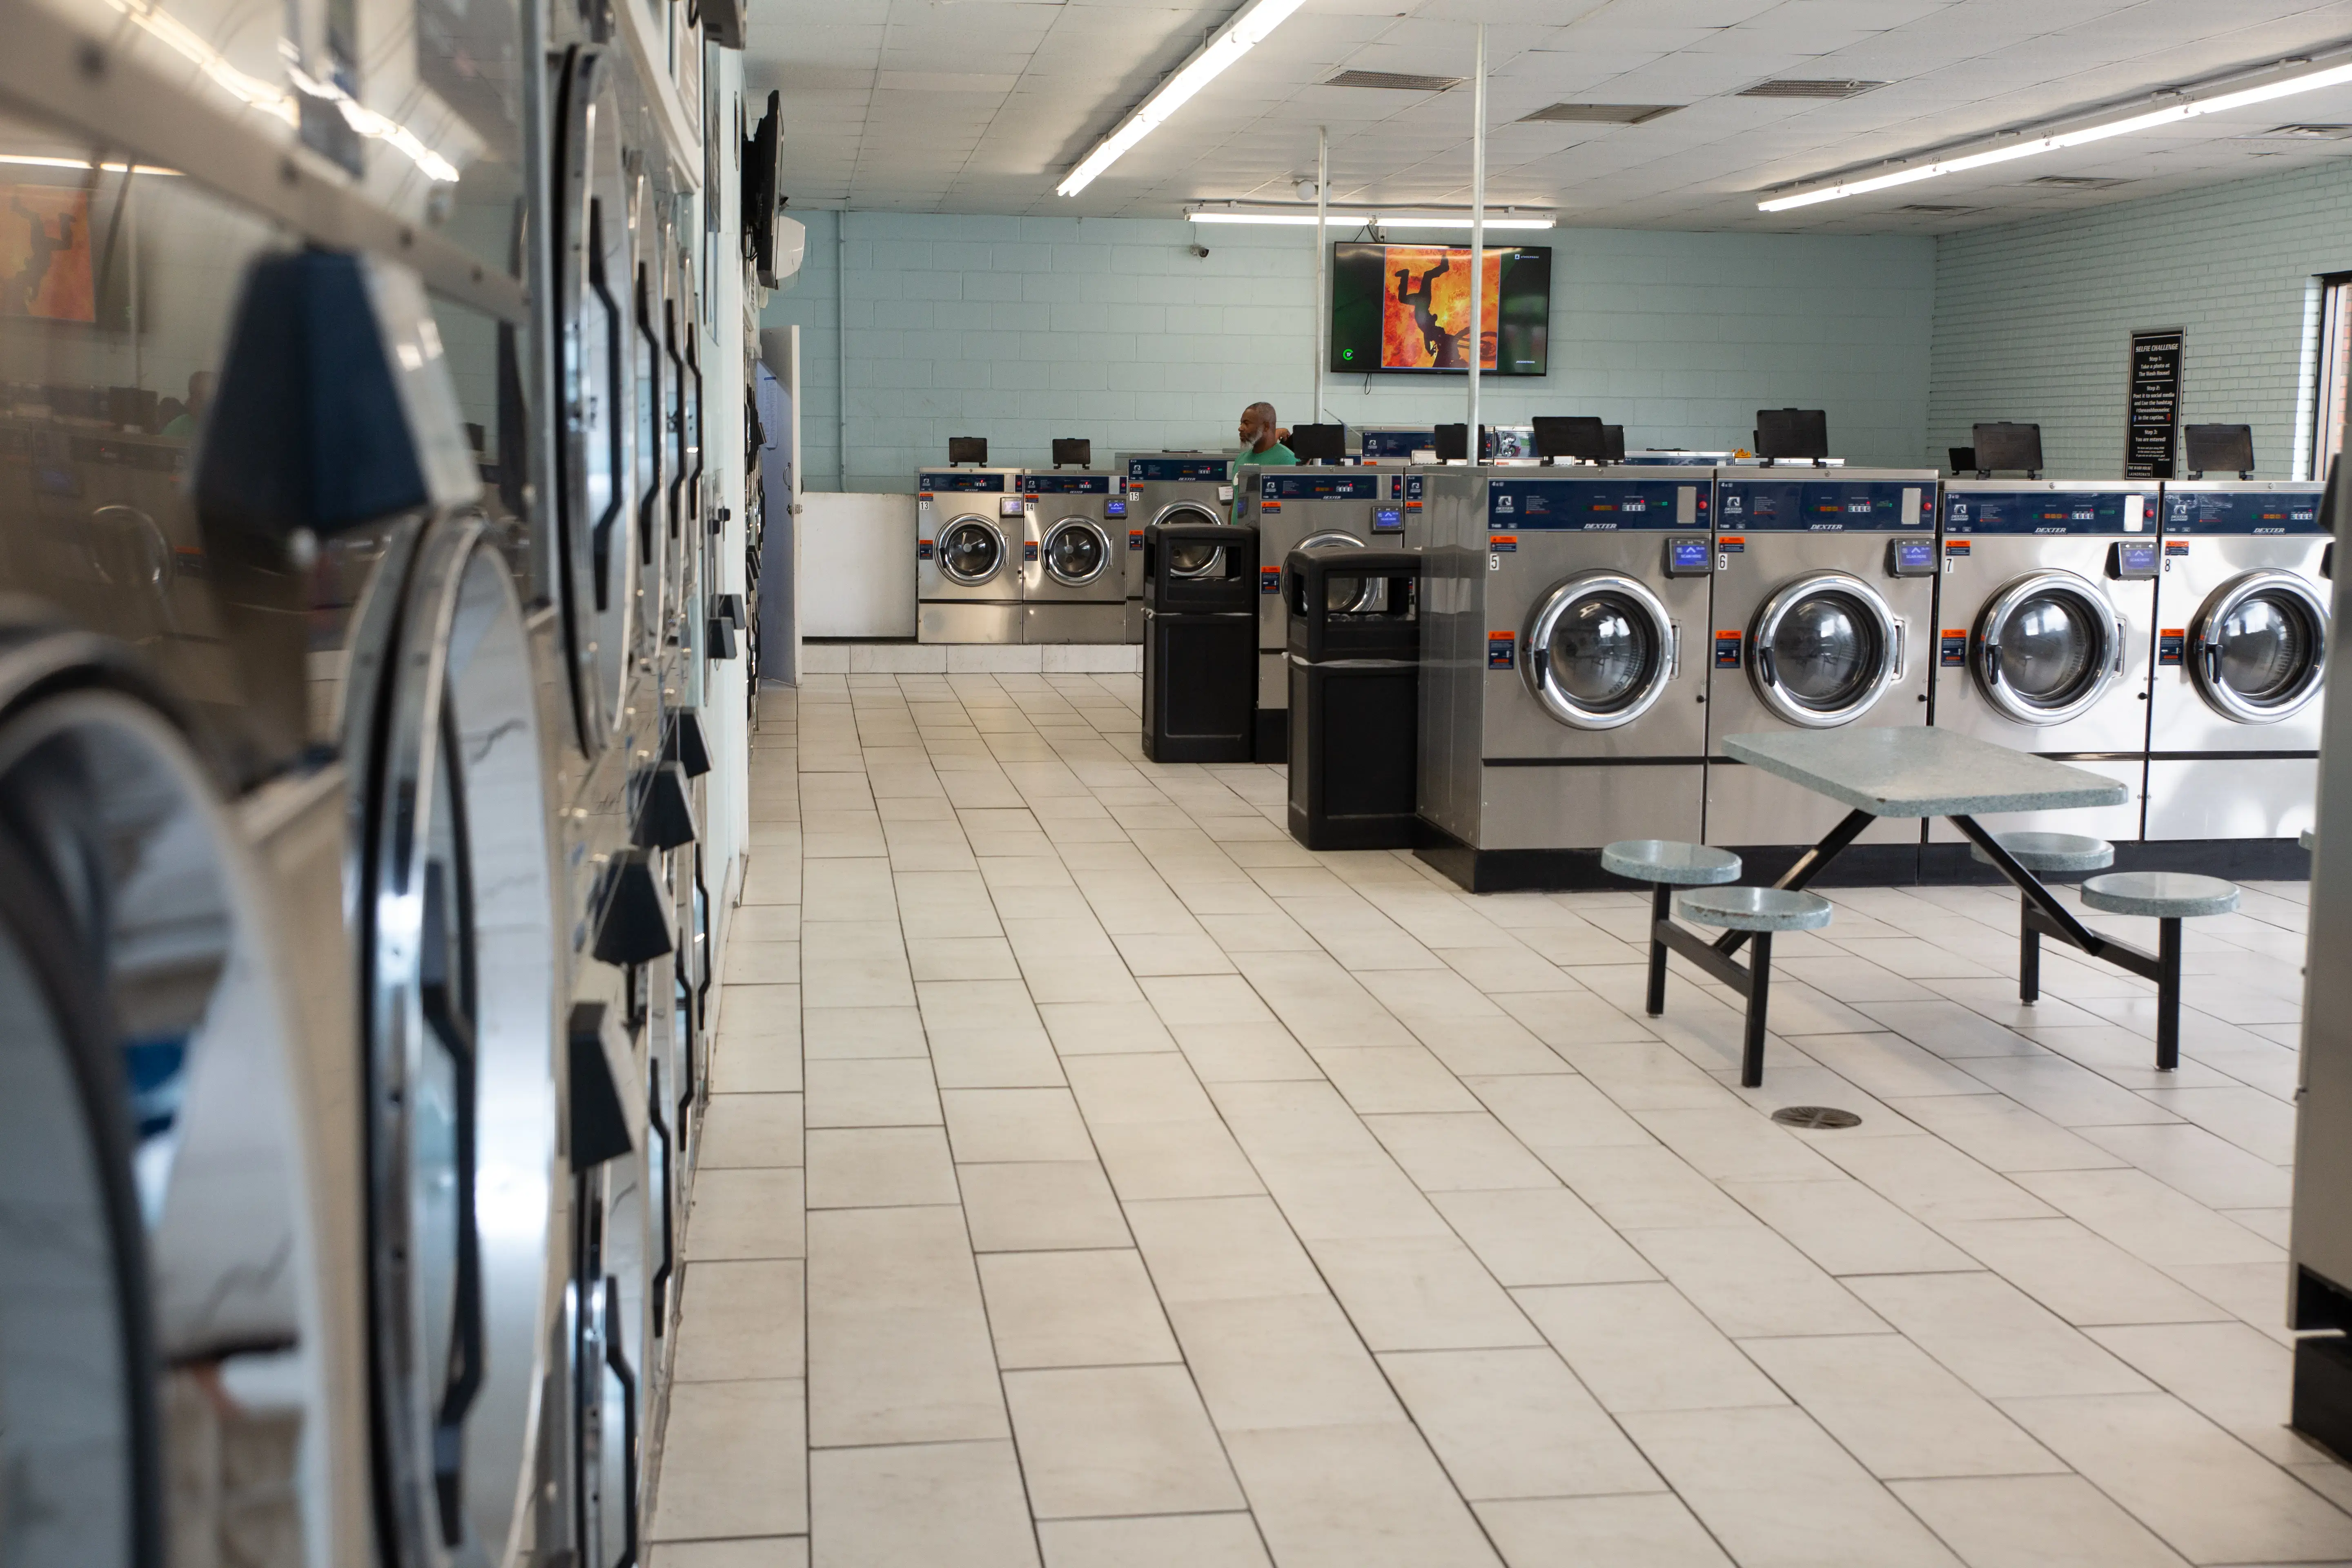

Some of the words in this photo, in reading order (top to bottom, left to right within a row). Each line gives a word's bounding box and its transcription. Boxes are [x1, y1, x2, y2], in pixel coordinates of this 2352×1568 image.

[920, 501, 928, 510] 13
[1490, 555, 1497, 569] 5
[1719, 555, 1725, 569] 6
[1946, 558, 1952, 572] 7
[2165, 559, 2170, 572] 8
